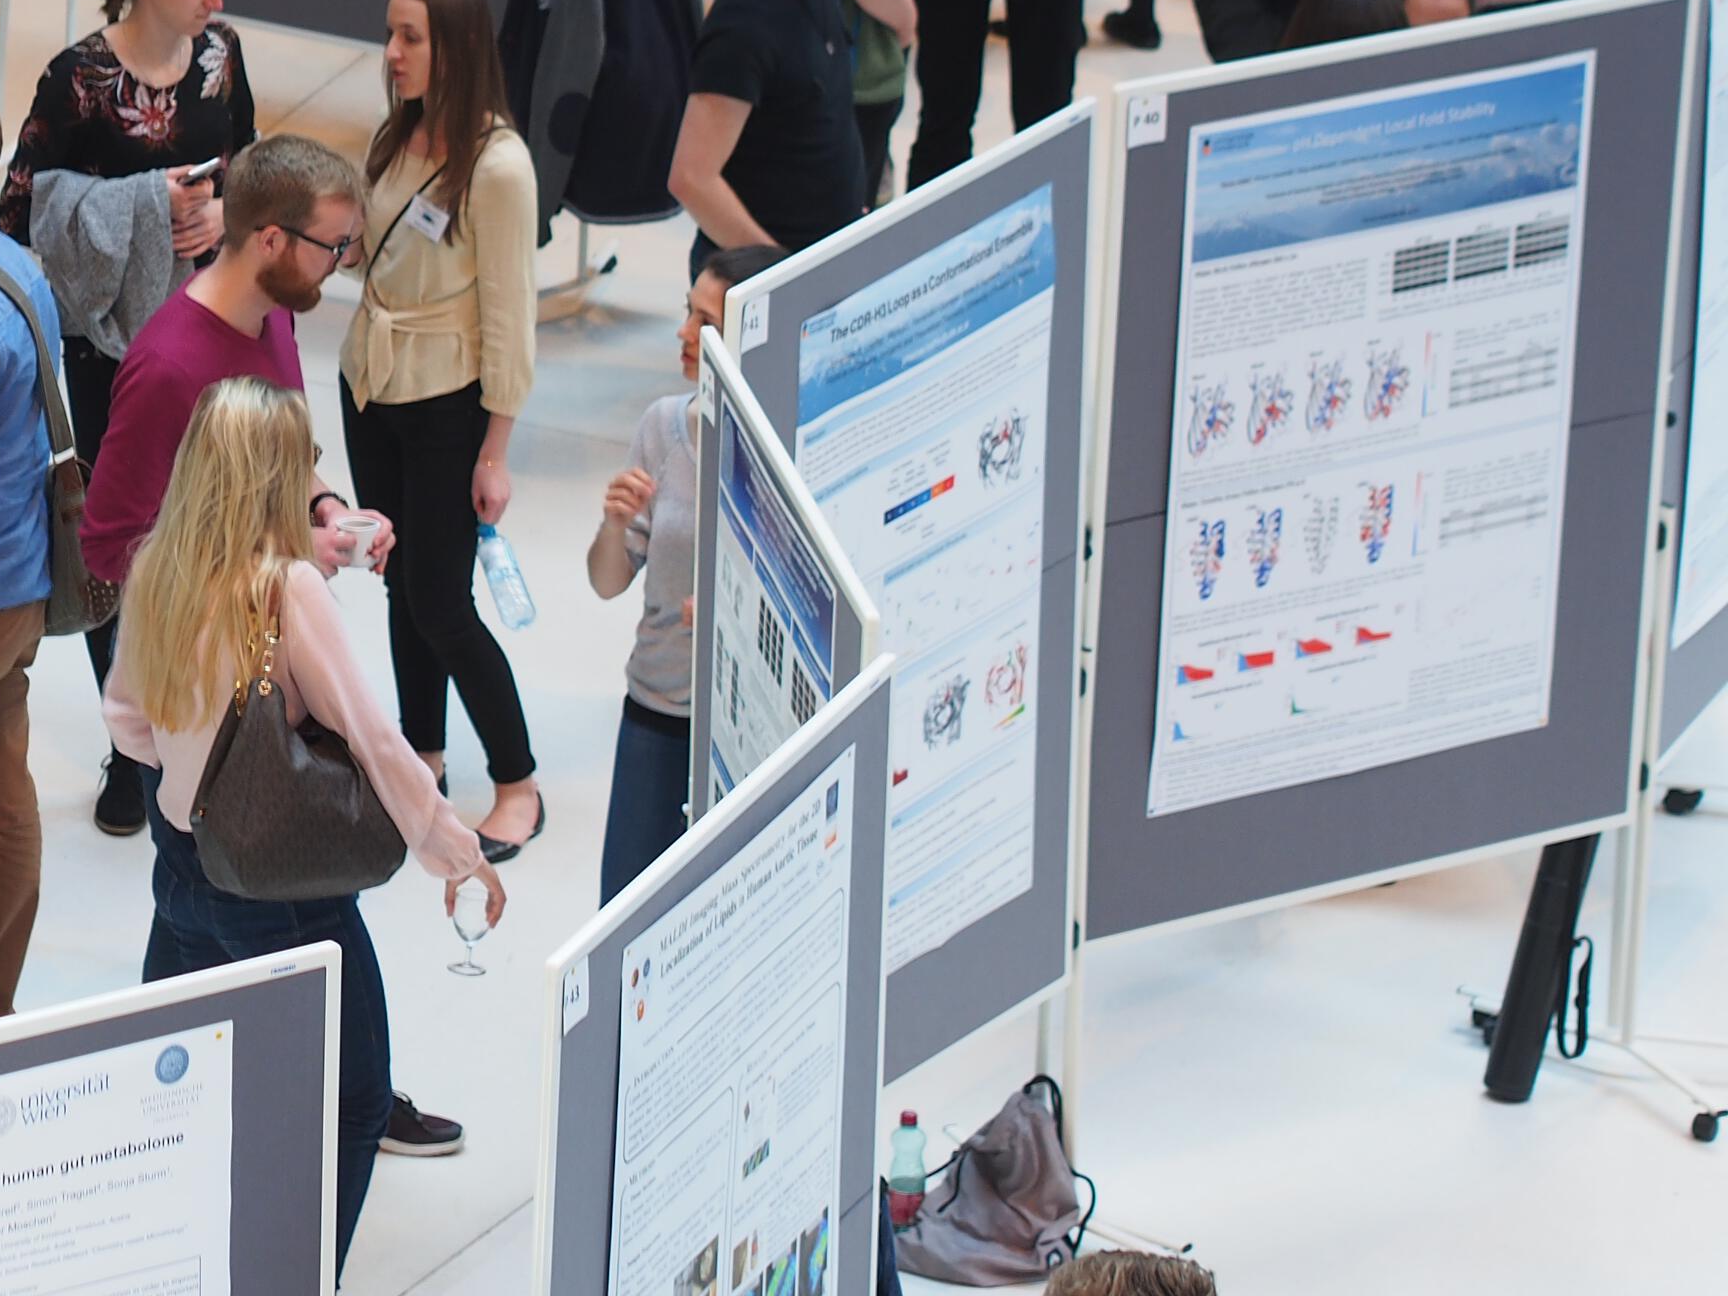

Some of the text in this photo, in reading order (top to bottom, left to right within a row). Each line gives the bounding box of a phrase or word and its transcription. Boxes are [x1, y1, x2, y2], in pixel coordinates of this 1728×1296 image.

[830, 324, 849, 344] The
[888, 292, 910, 316] Loop
[911, 289, 922, 301] as
[923, 285, 928, 295] a
[928, 245, 994, 291] Conformational
[995, 218, 1034, 253] Ensemble
[660, 931, 704, 979] Localization
[705, 919, 713, 936] of
[714, 901, 738, 929] Lipids
[746, 870, 773, 901] Human
[797, 828, 819, 854] Tissue
[19, 1072, 111, 1112] universität
[1, 1162, 55, 1187] human
[60, 1154, 85, 1174] gut
[90, 1131, 185, 1166] metabolome
